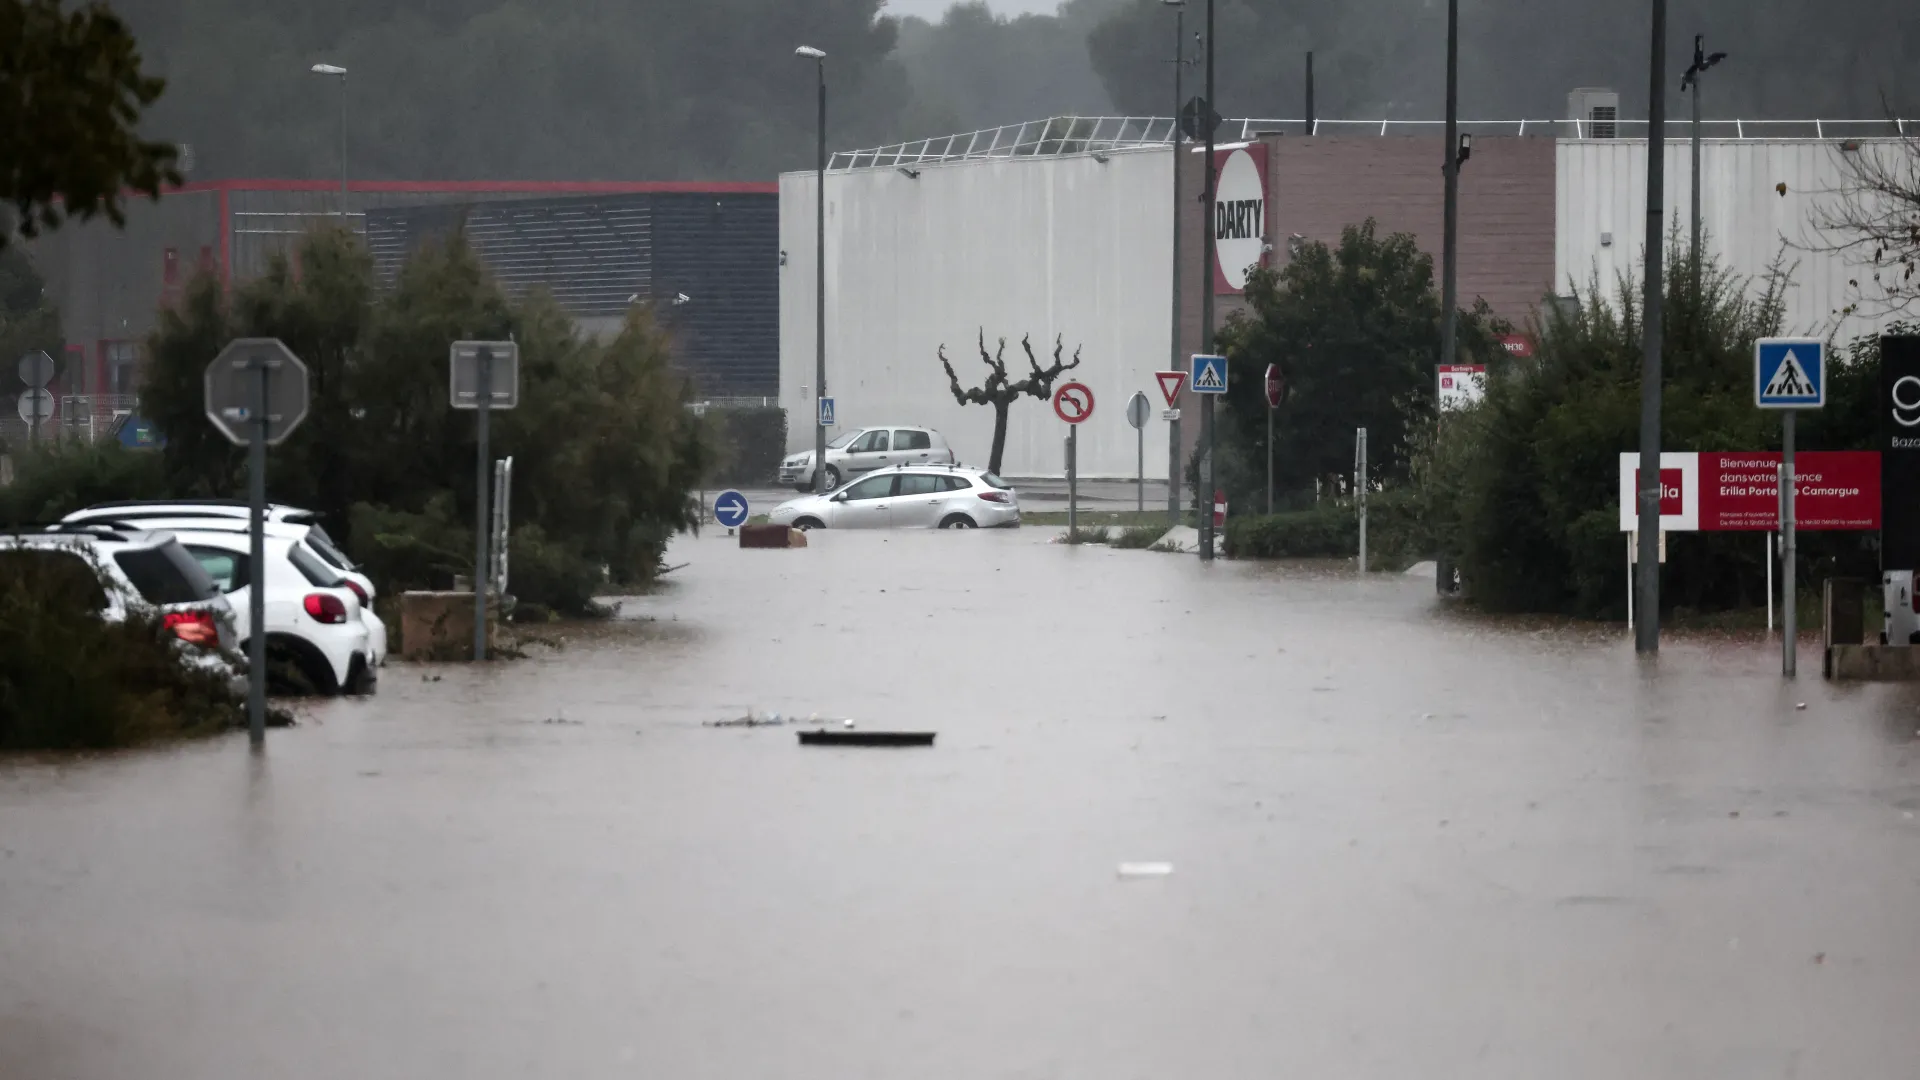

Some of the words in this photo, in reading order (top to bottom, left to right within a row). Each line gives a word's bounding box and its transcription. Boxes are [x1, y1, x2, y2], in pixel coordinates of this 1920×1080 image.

[1216, 199, 1262, 240] DARTY
[1720, 458, 1776, 468] Bienvenue
[1720, 473, 1747, 482] dans
[1748, 474, 1776, 482] votre
[1795, 473, 1822, 482] ence
[1660, 482, 1679, 499] lia
[1720, 486, 1746, 496] Erilia
[1749, 486, 1777, 496] Porte
[1802, 486, 1859, 498] Camargue
